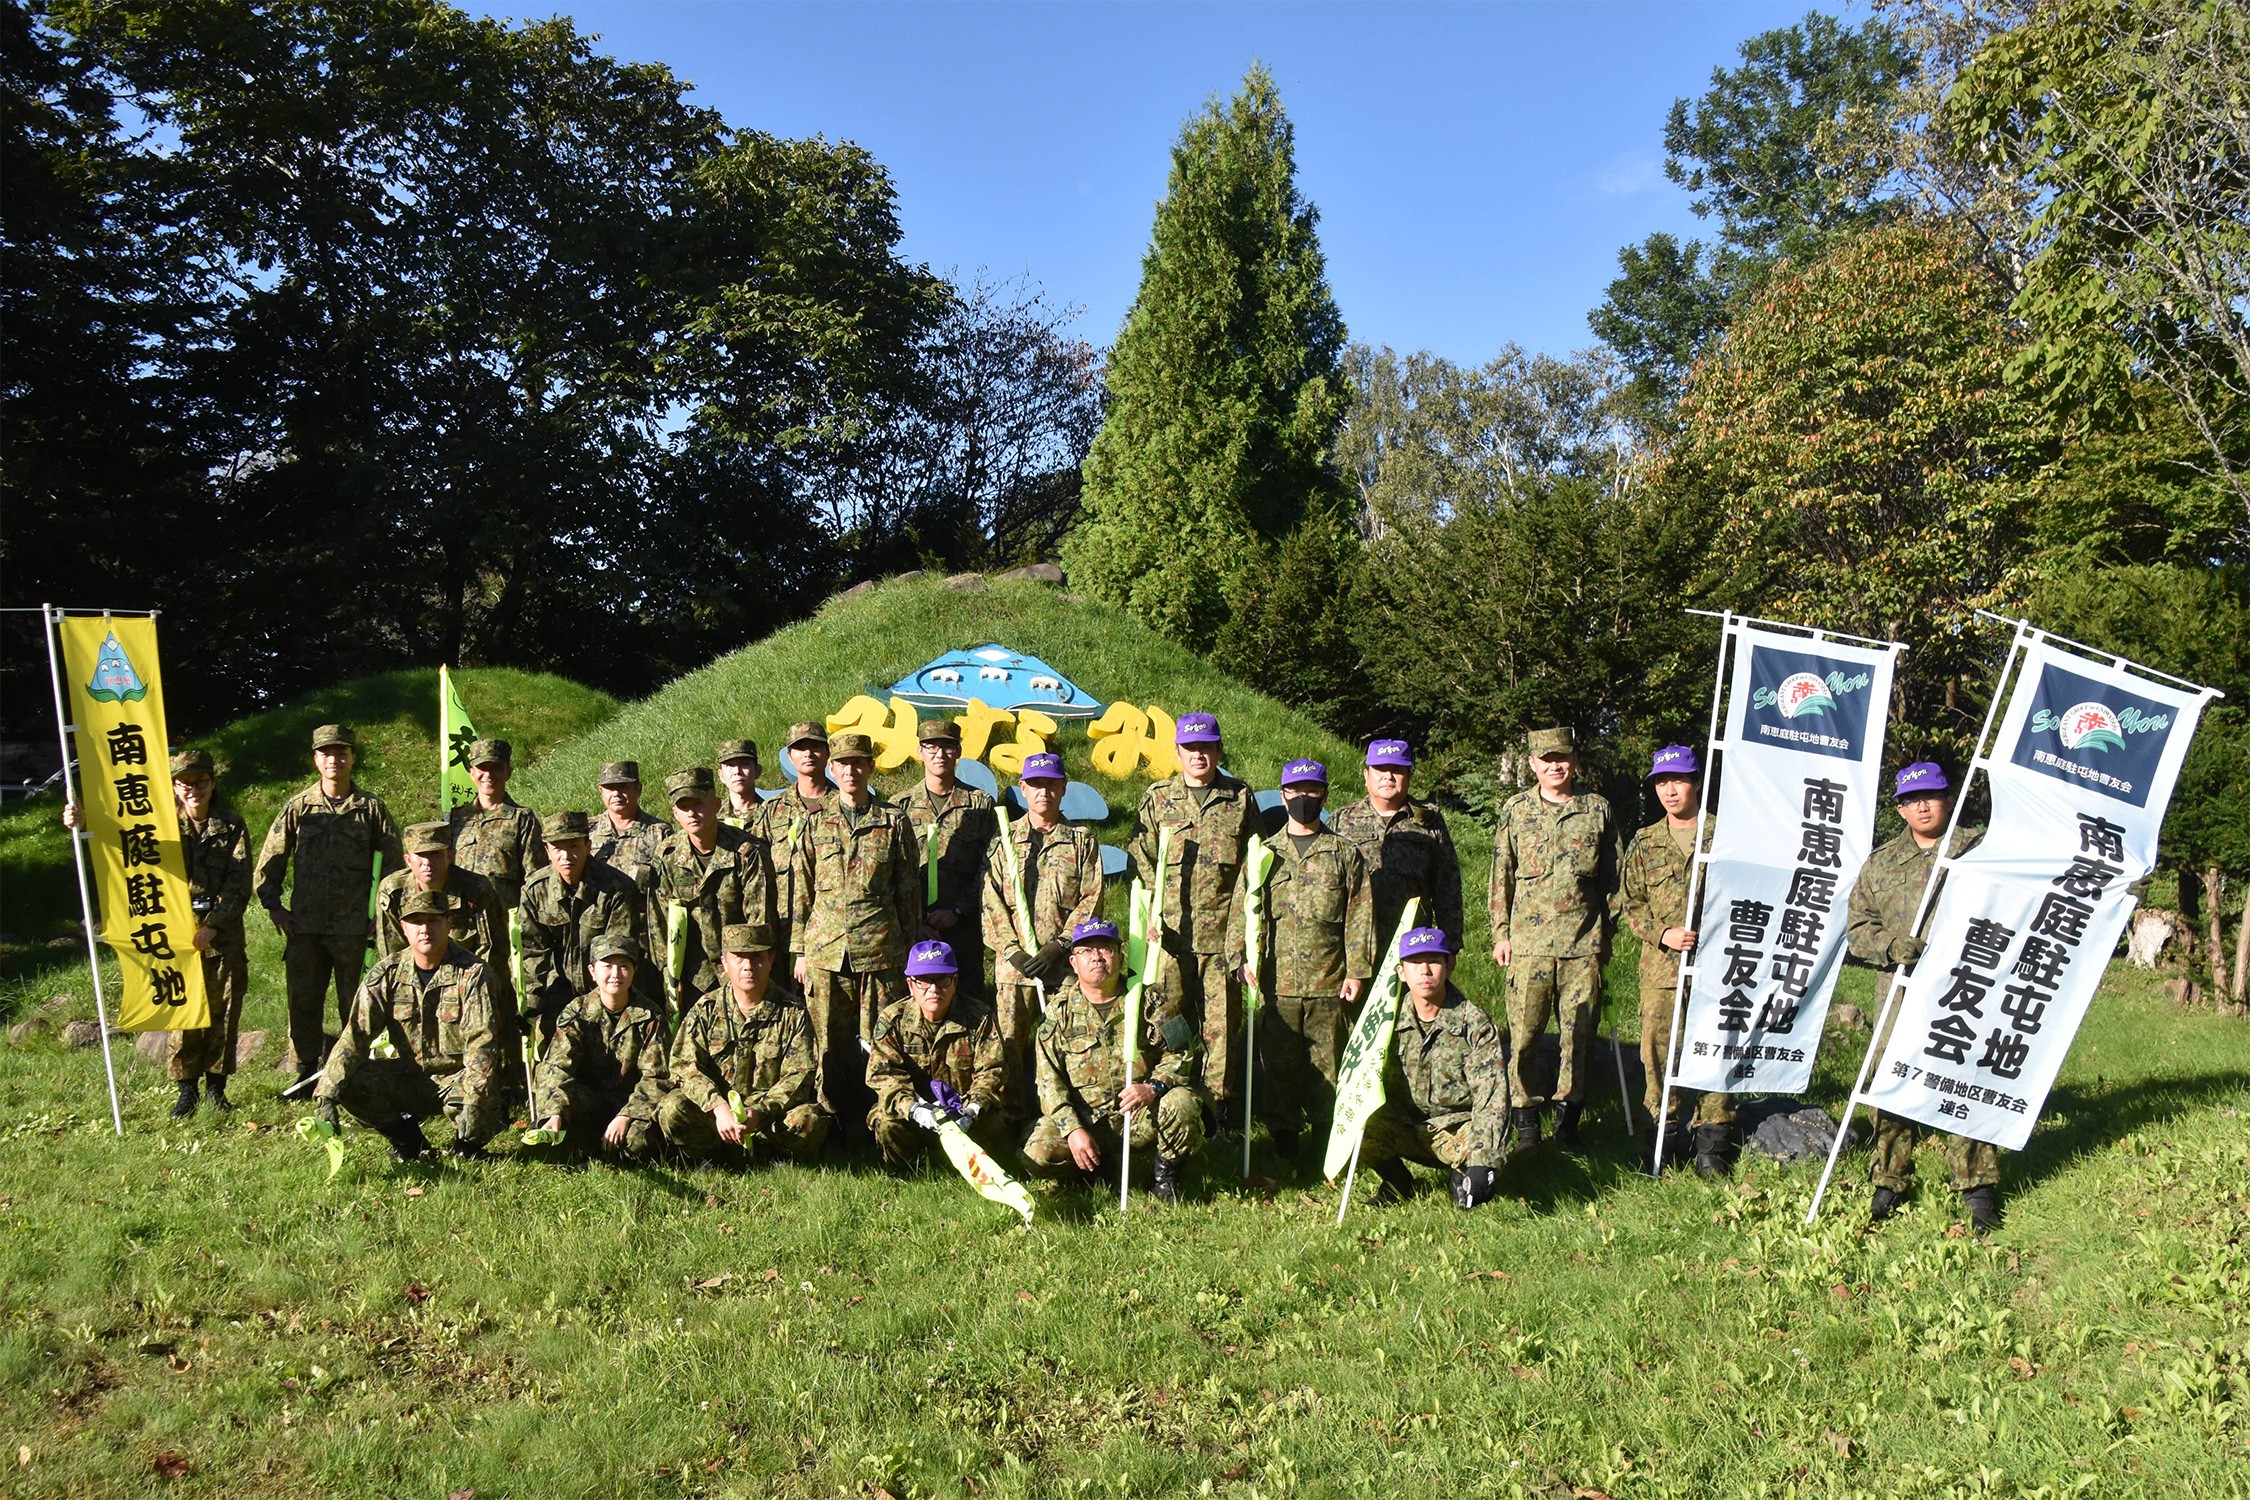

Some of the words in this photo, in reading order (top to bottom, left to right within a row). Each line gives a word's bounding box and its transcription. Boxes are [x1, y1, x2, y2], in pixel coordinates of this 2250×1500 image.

[1753, 686, 1778, 710] So
[1824, 670, 1869, 695] You
[2031, 708, 2060, 733] So
[2117, 707, 2168, 734] You
[826, 695, 1184, 781] みなみ
[1760, 724, 1849, 750] 南恵庭駐屯地曹友会
[2032, 749, 2133, 794] 南恵庭駐屯地曹友会
[107, 722, 187, 1006] 南恵庭駐屯地
[1755, 777, 1848, 1035] 南恵庭駐屯地
[1717, 899, 1774, 1034] 曹友会
[1976, 812, 2126, 1080] 南恵庭駐屯地
[1923, 917, 2016, 1065] 曹友会
[1937, 1098, 1970, 1120] 連合
